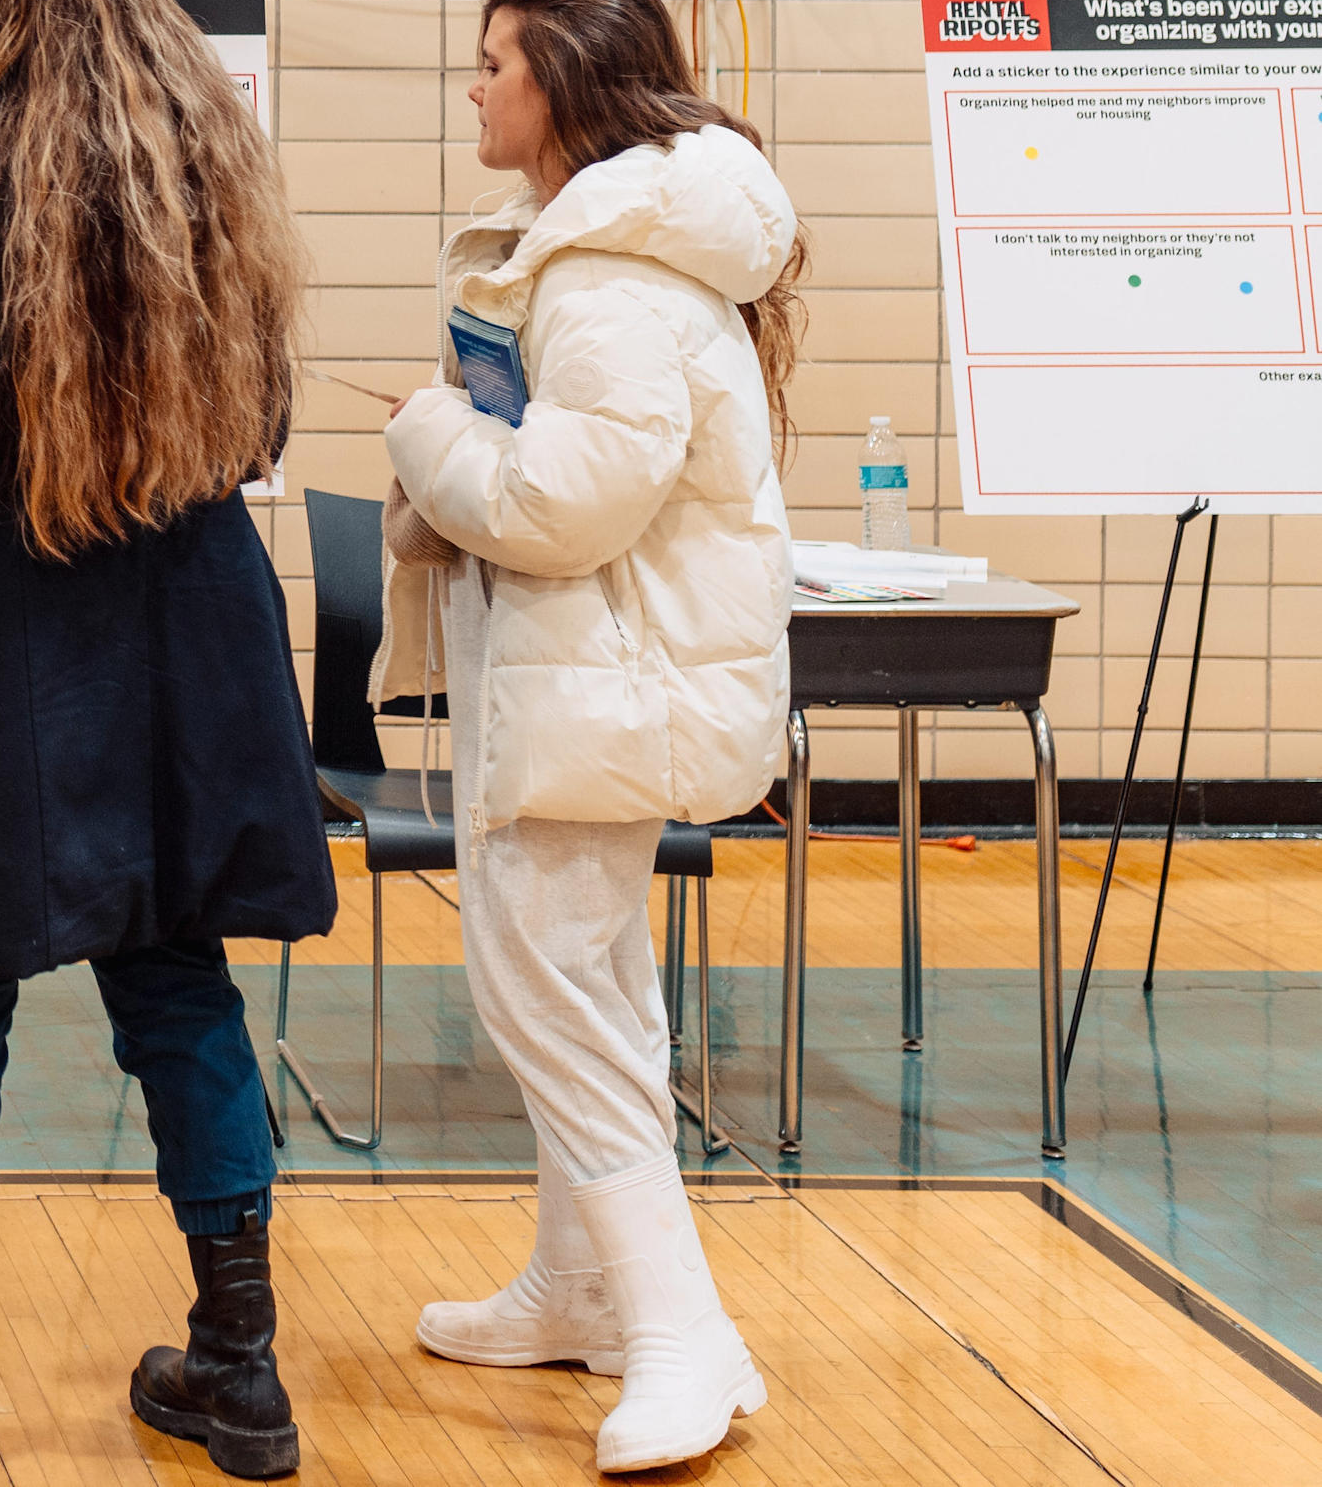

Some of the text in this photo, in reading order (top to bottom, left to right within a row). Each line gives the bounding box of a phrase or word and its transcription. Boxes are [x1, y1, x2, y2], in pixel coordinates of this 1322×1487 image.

[948, 1, 1031, 18] RENTAL
[1227, 0, 1279, 19] your
[940, 18, 1041, 40] RIPOFFS
[1095, 19, 1271, 44] organizing with
[952, 64, 1296, 77] Add a sticker to the experience similar to your
